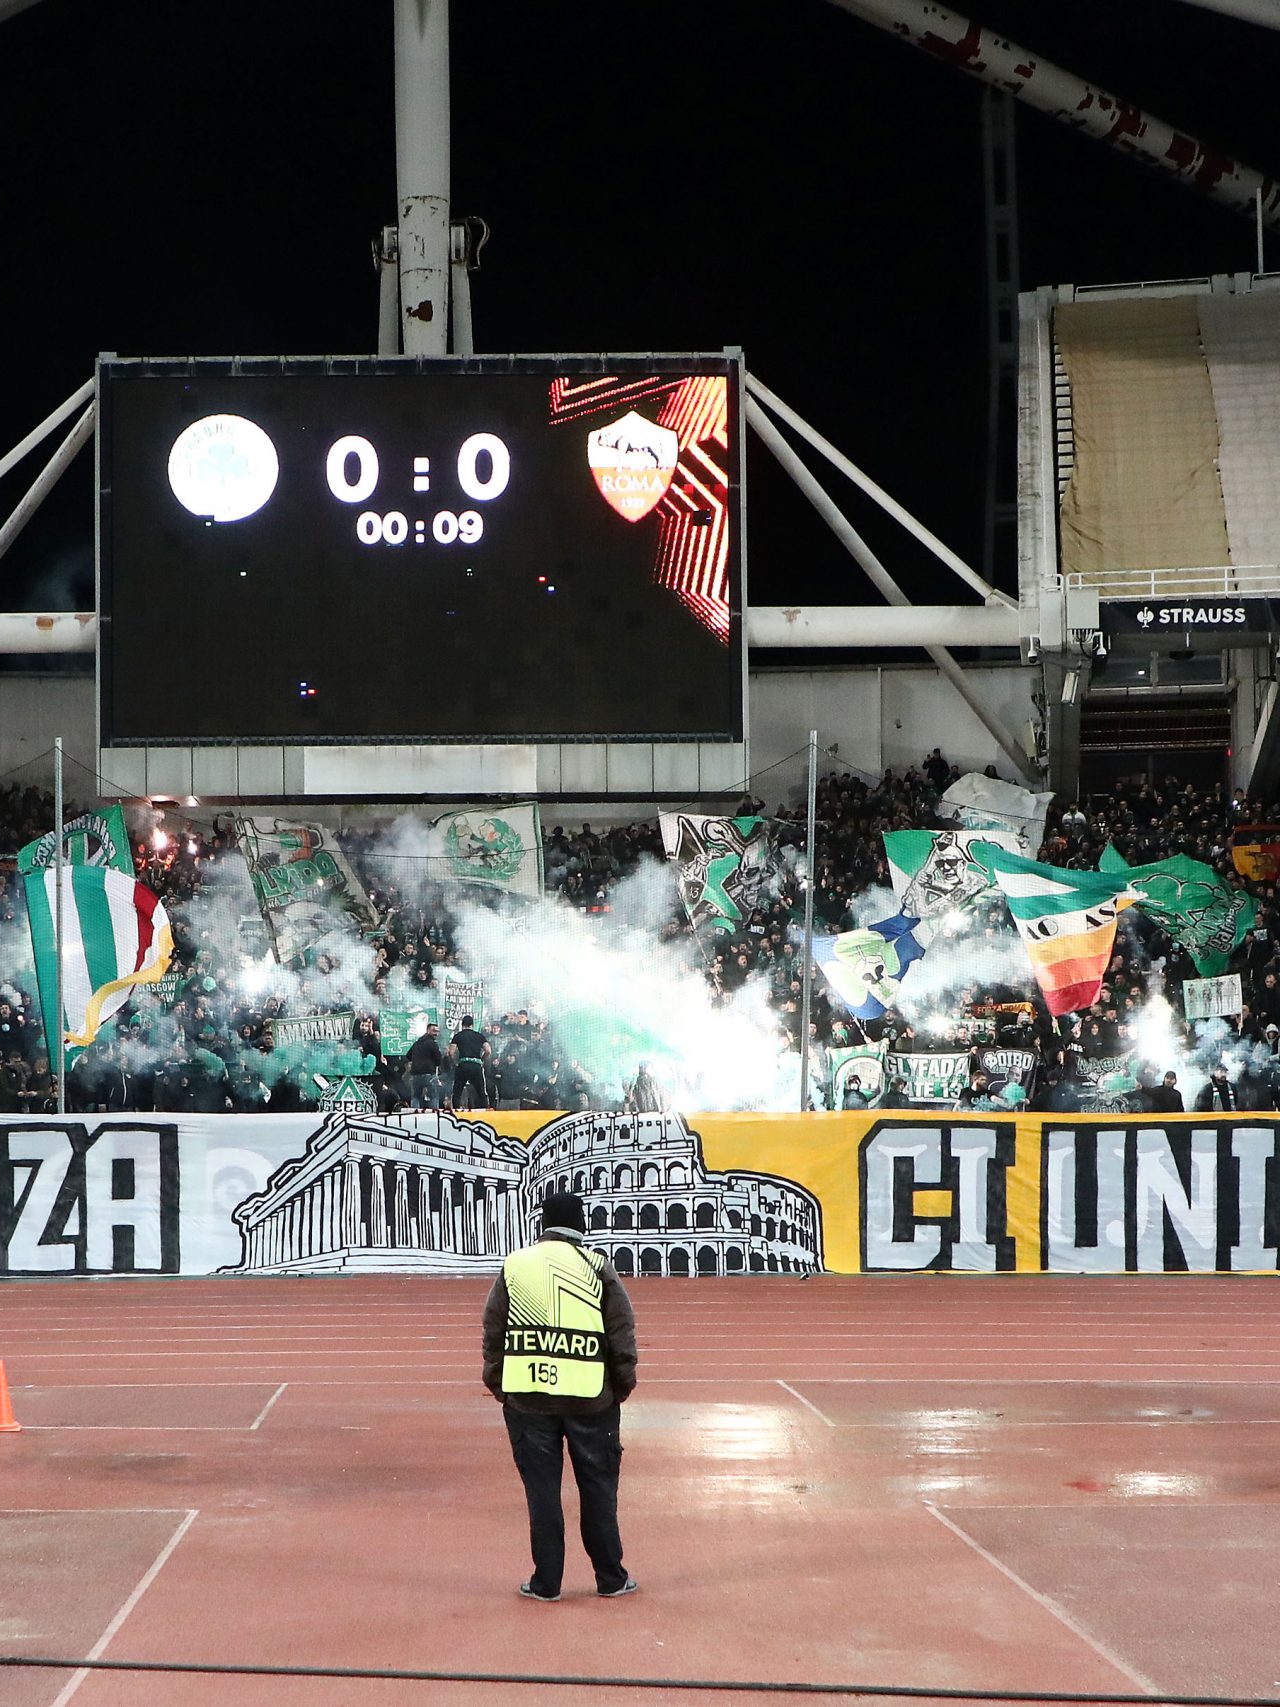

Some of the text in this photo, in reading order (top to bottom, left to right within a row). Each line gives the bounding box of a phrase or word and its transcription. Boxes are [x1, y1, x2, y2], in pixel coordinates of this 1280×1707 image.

[326, 435, 379, 503] 0
[457, 432, 510, 501] 0
[601, 474, 665, 493] ROMA
[356, 511, 483, 545] 00:09
[1158, 607, 1246, 624] STRAUSS
[887, 1056, 970, 1077] GLYFADA
[904, 1081, 965, 1099] ATE 13
[323, 1100, 376, 1112] GREEN
[858, 1118, 1017, 1273] CI
[528, 1362, 558, 1386] 158
